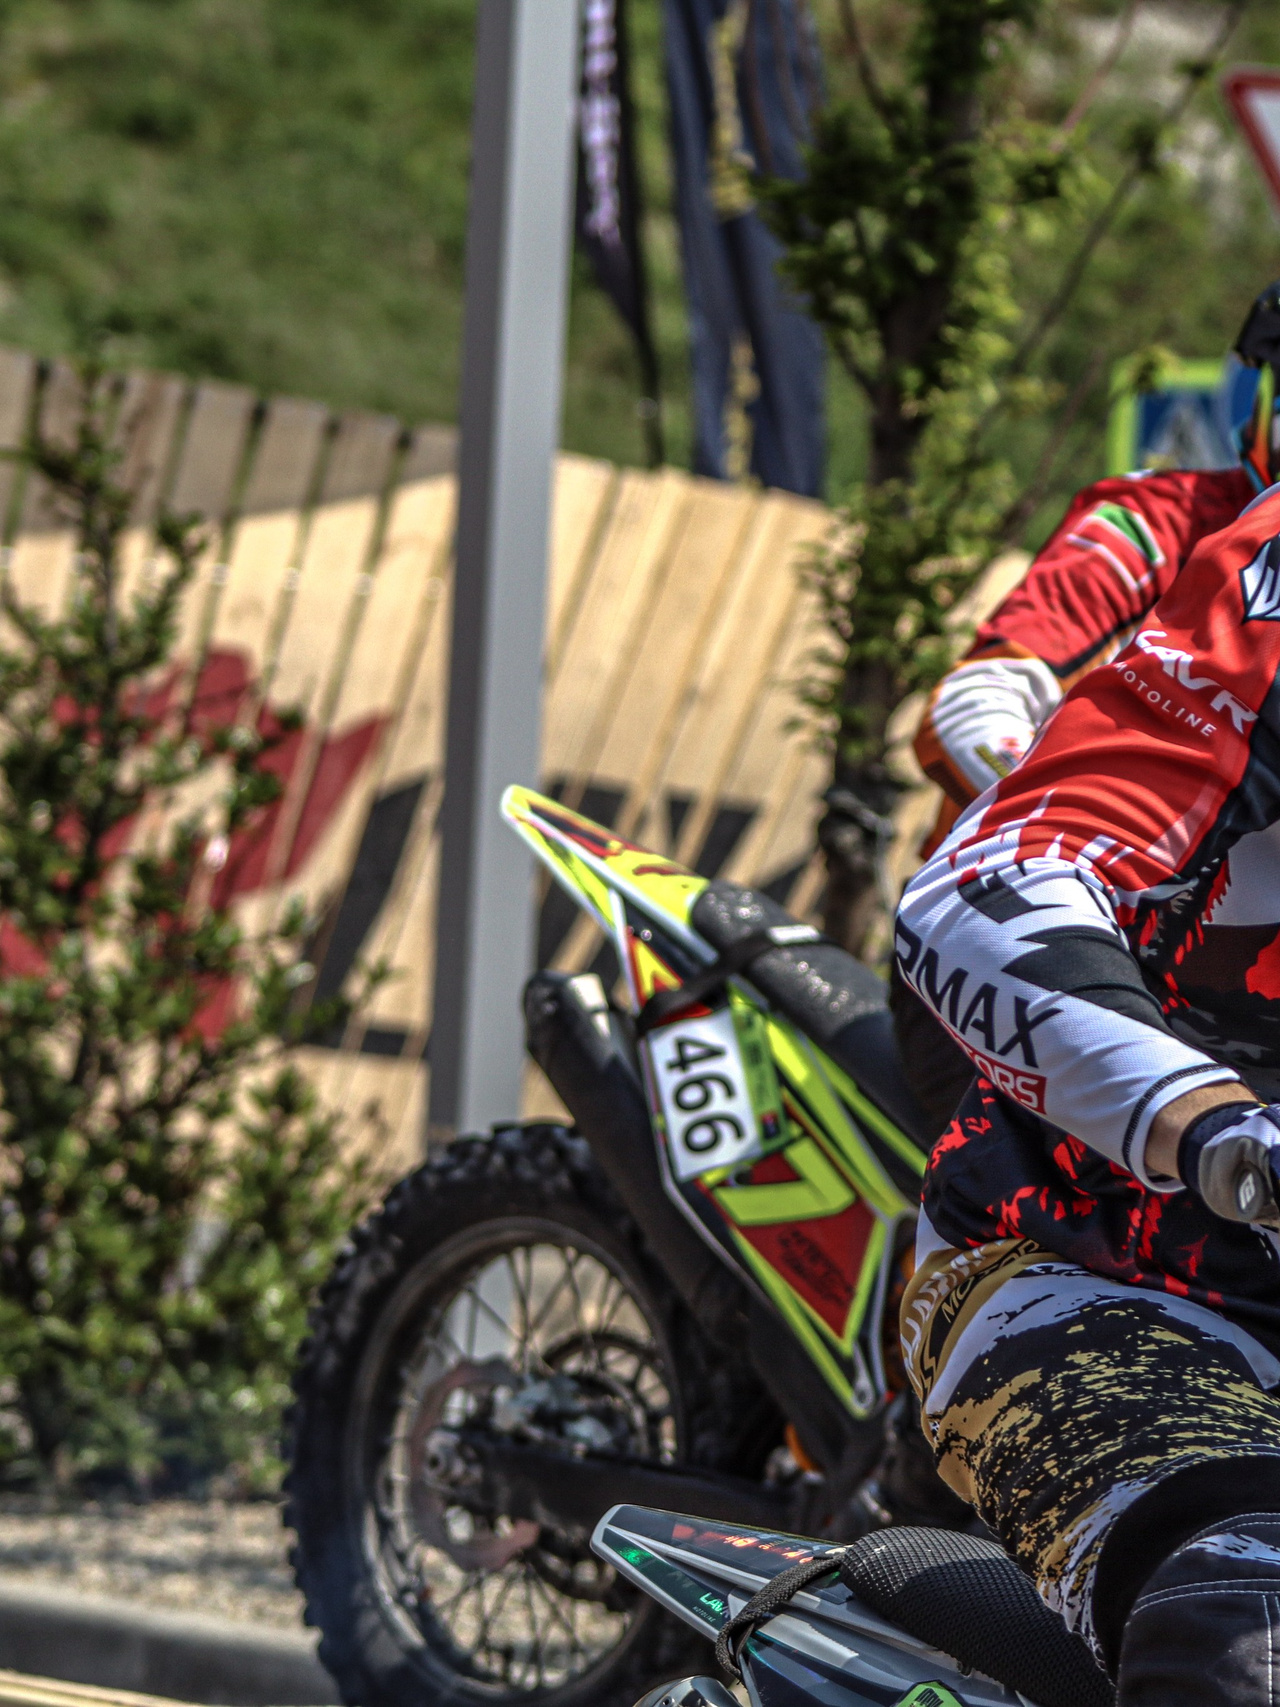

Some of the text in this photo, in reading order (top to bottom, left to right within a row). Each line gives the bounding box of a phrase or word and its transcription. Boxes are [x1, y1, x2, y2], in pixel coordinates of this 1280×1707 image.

[1113, 660, 1217, 738] MOTOLINE
[1133, 629, 1261, 736] LAVR
[664, 1032, 748, 1155] 466
